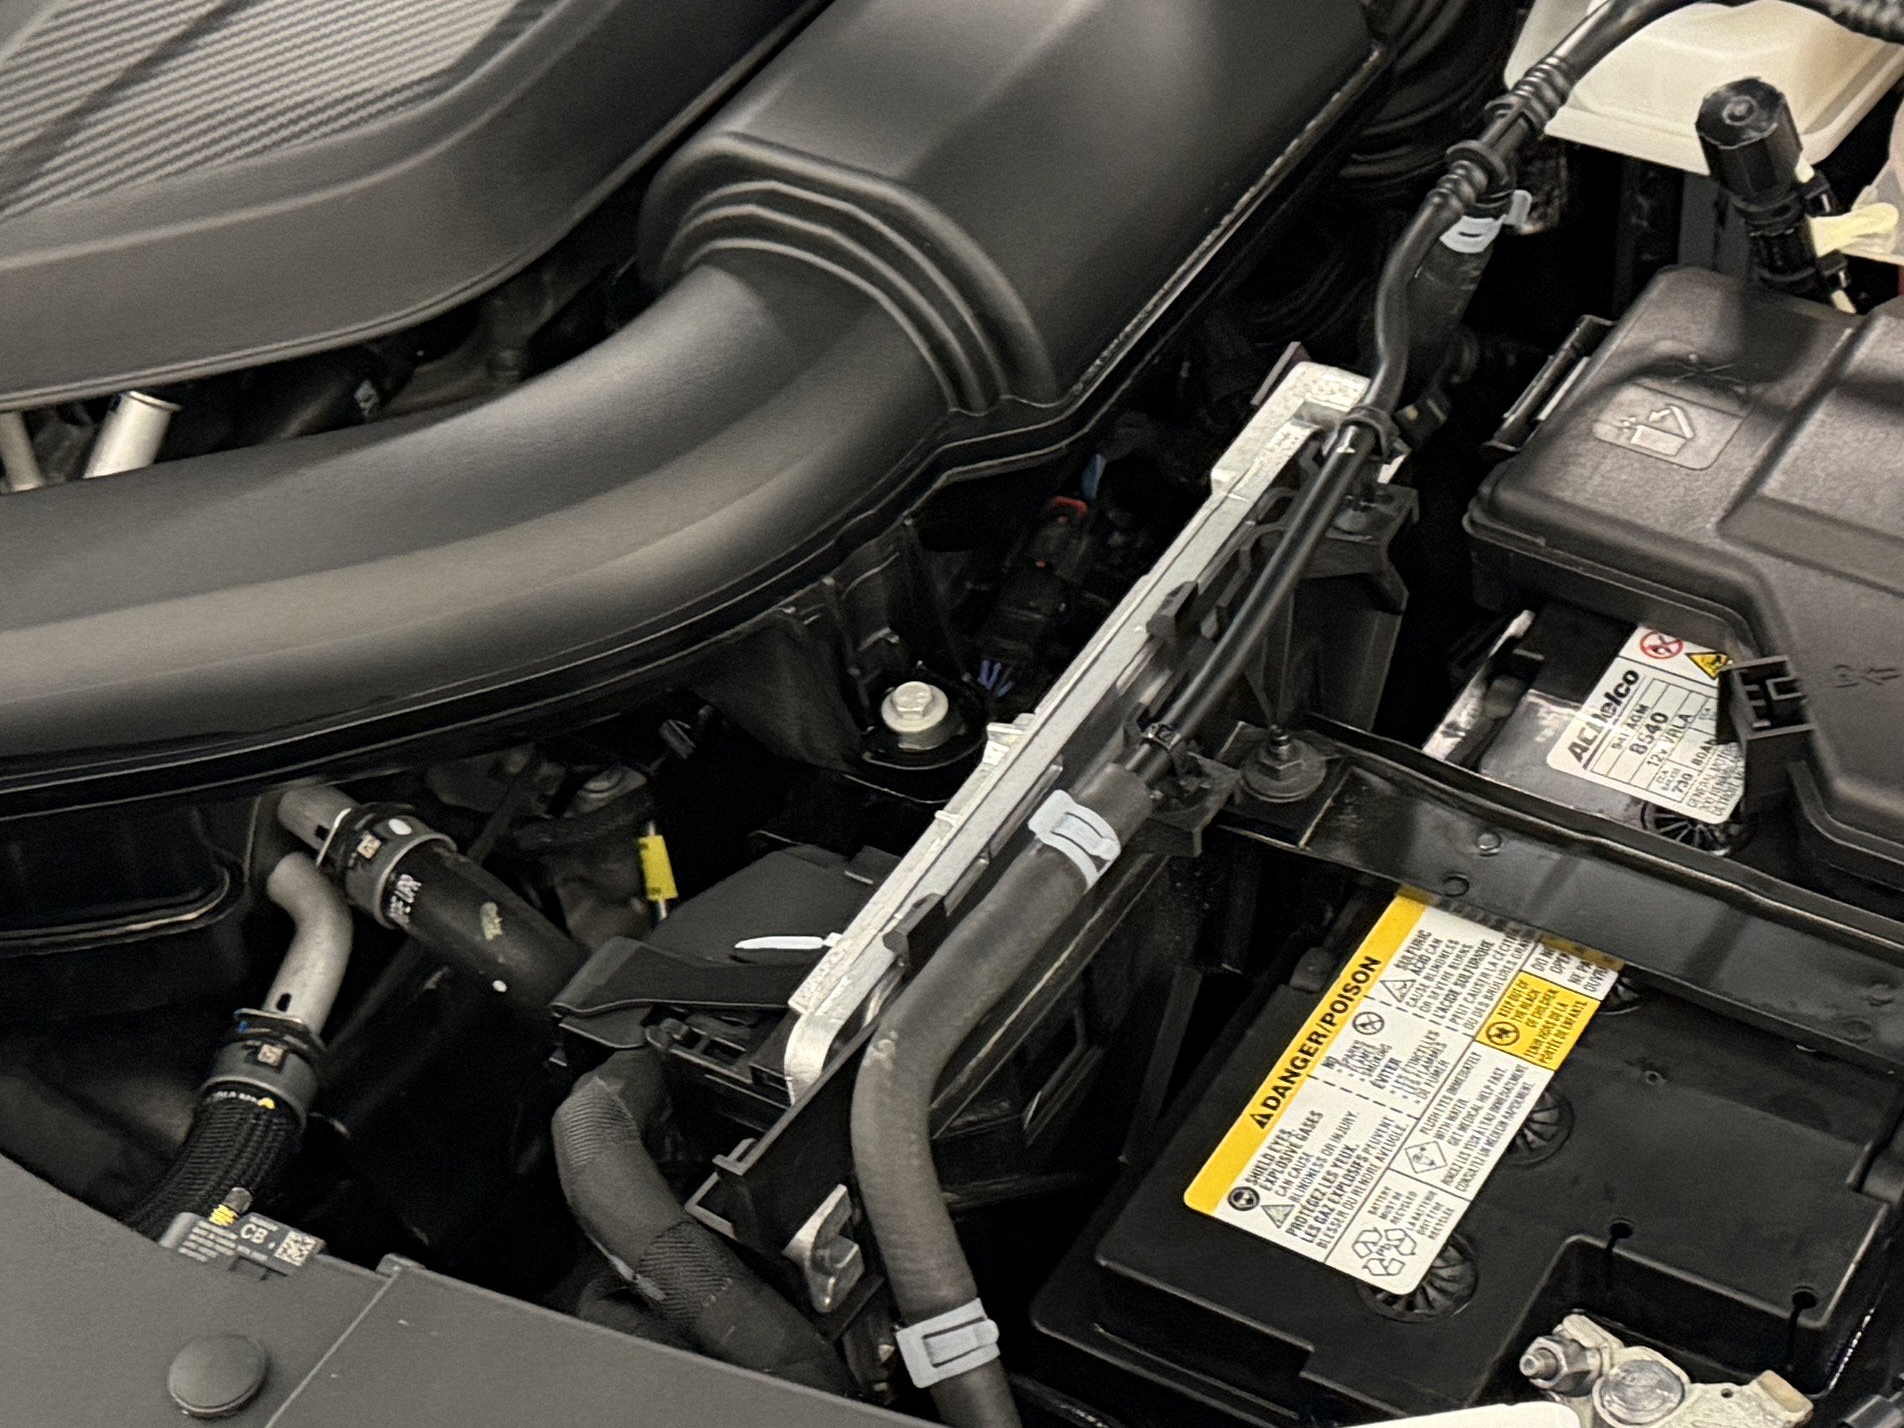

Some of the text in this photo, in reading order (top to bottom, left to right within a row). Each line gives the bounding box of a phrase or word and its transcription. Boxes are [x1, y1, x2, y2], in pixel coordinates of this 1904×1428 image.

[1569, 670, 1638, 761] ACDelco
[1409, 938, 1442, 975] ACID CAN
[1405, 982, 1430, 1007] CAUSE
[1262, 956, 1379, 1109] DANGER/POISON
[1244, 1152, 1275, 1185] SHIELD
[1259, 1110, 1323, 1191] EXPLOSIVE GASES
[1274, 1151, 1313, 1197] CAN CAUSE
[1288, 1156, 1327, 1203] BLINDNESS
[1321, 1143, 1337, 1156] OR
[1300, 1116, 1394, 1243] LES GAZ EXPLOSIFS PEUVENT
[1317, 1170, 1338, 1188] LES
[1316, 1210, 1348, 1249] BLESSER
[1341, 1196, 1357, 1210] OU
